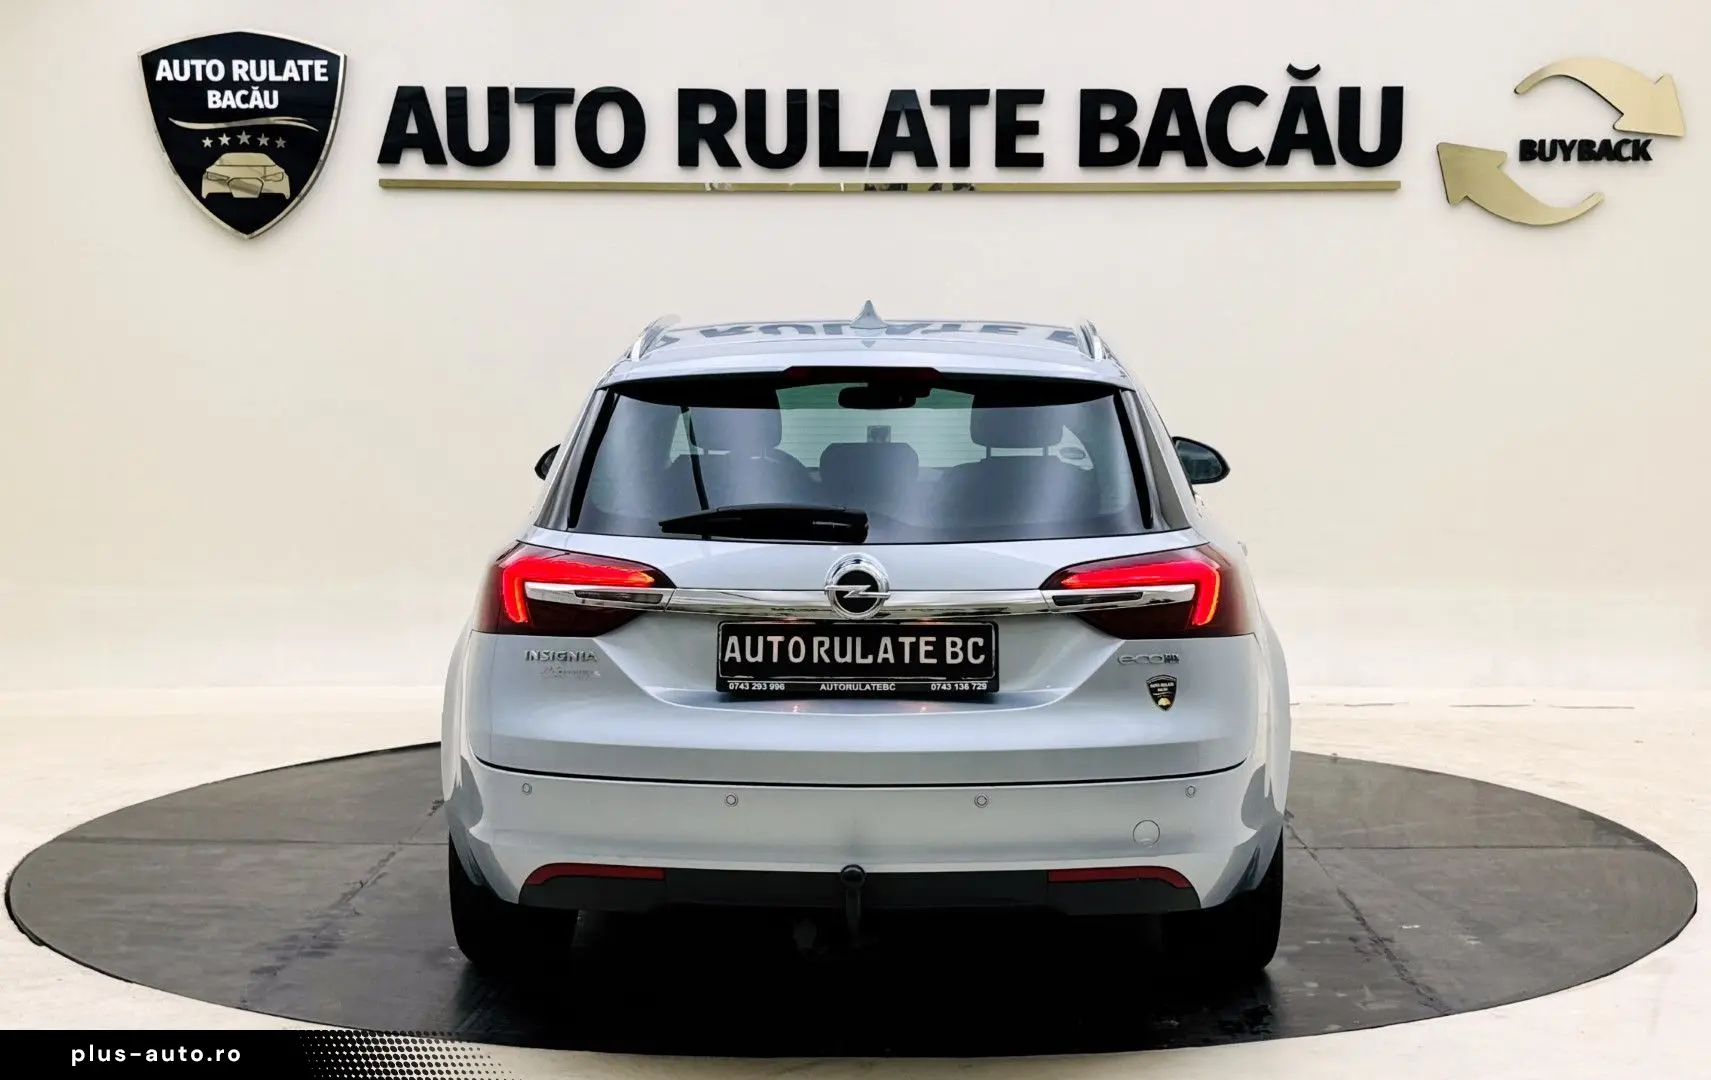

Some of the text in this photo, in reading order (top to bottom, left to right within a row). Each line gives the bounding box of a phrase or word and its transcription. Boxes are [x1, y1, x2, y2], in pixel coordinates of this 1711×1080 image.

[156, 58, 329, 82] AUTO RULATE
[207, 86, 279, 109] BACĂU
[377, 63, 1404, 169] AUTO RULATE BACĂU
[1518, 138, 1653, 162] BUYBACK
[524, 649, 598, 662] INSIGNIA
[724, 635, 986, 664] AUTO RULATE BC
[728, 682, 785, 691] 0743 293 996
[819, 683, 896, 691] AUTORULATEBC
[930, 683, 952, 691] 0743
[971, 682, 988, 691] 729
